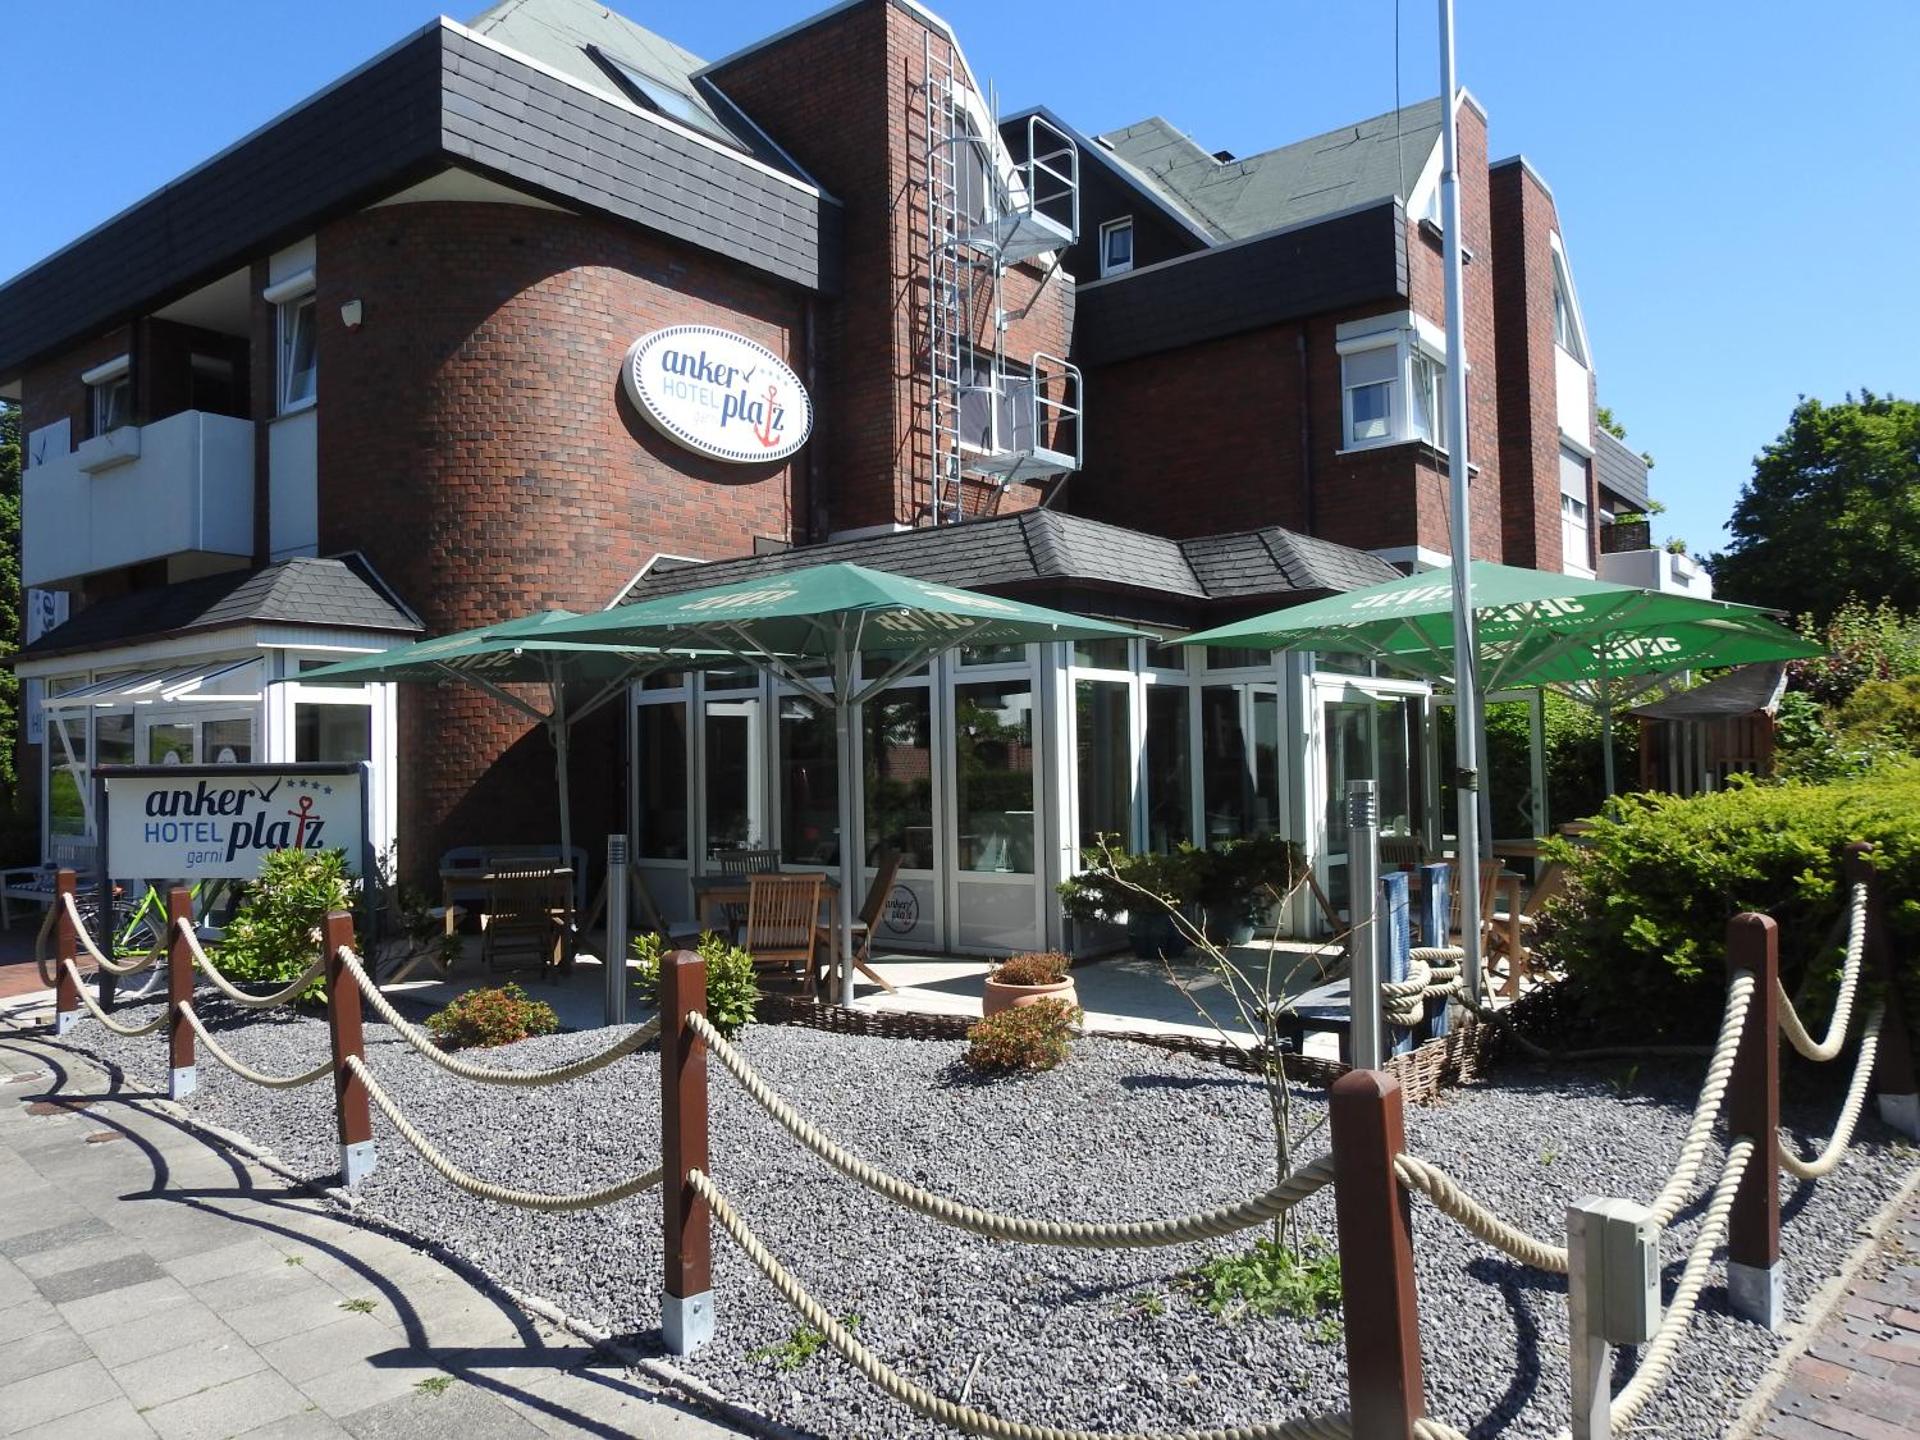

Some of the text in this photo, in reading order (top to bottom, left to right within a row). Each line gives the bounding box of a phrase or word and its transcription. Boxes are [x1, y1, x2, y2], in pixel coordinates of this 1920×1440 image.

[661, 349, 740, 388] anker
[663, 376, 720, 409] HOTEL
[145, 780, 254, 817] anker
[145, 821, 224, 844] HOTEL
[186, 849, 224, 869] garni
